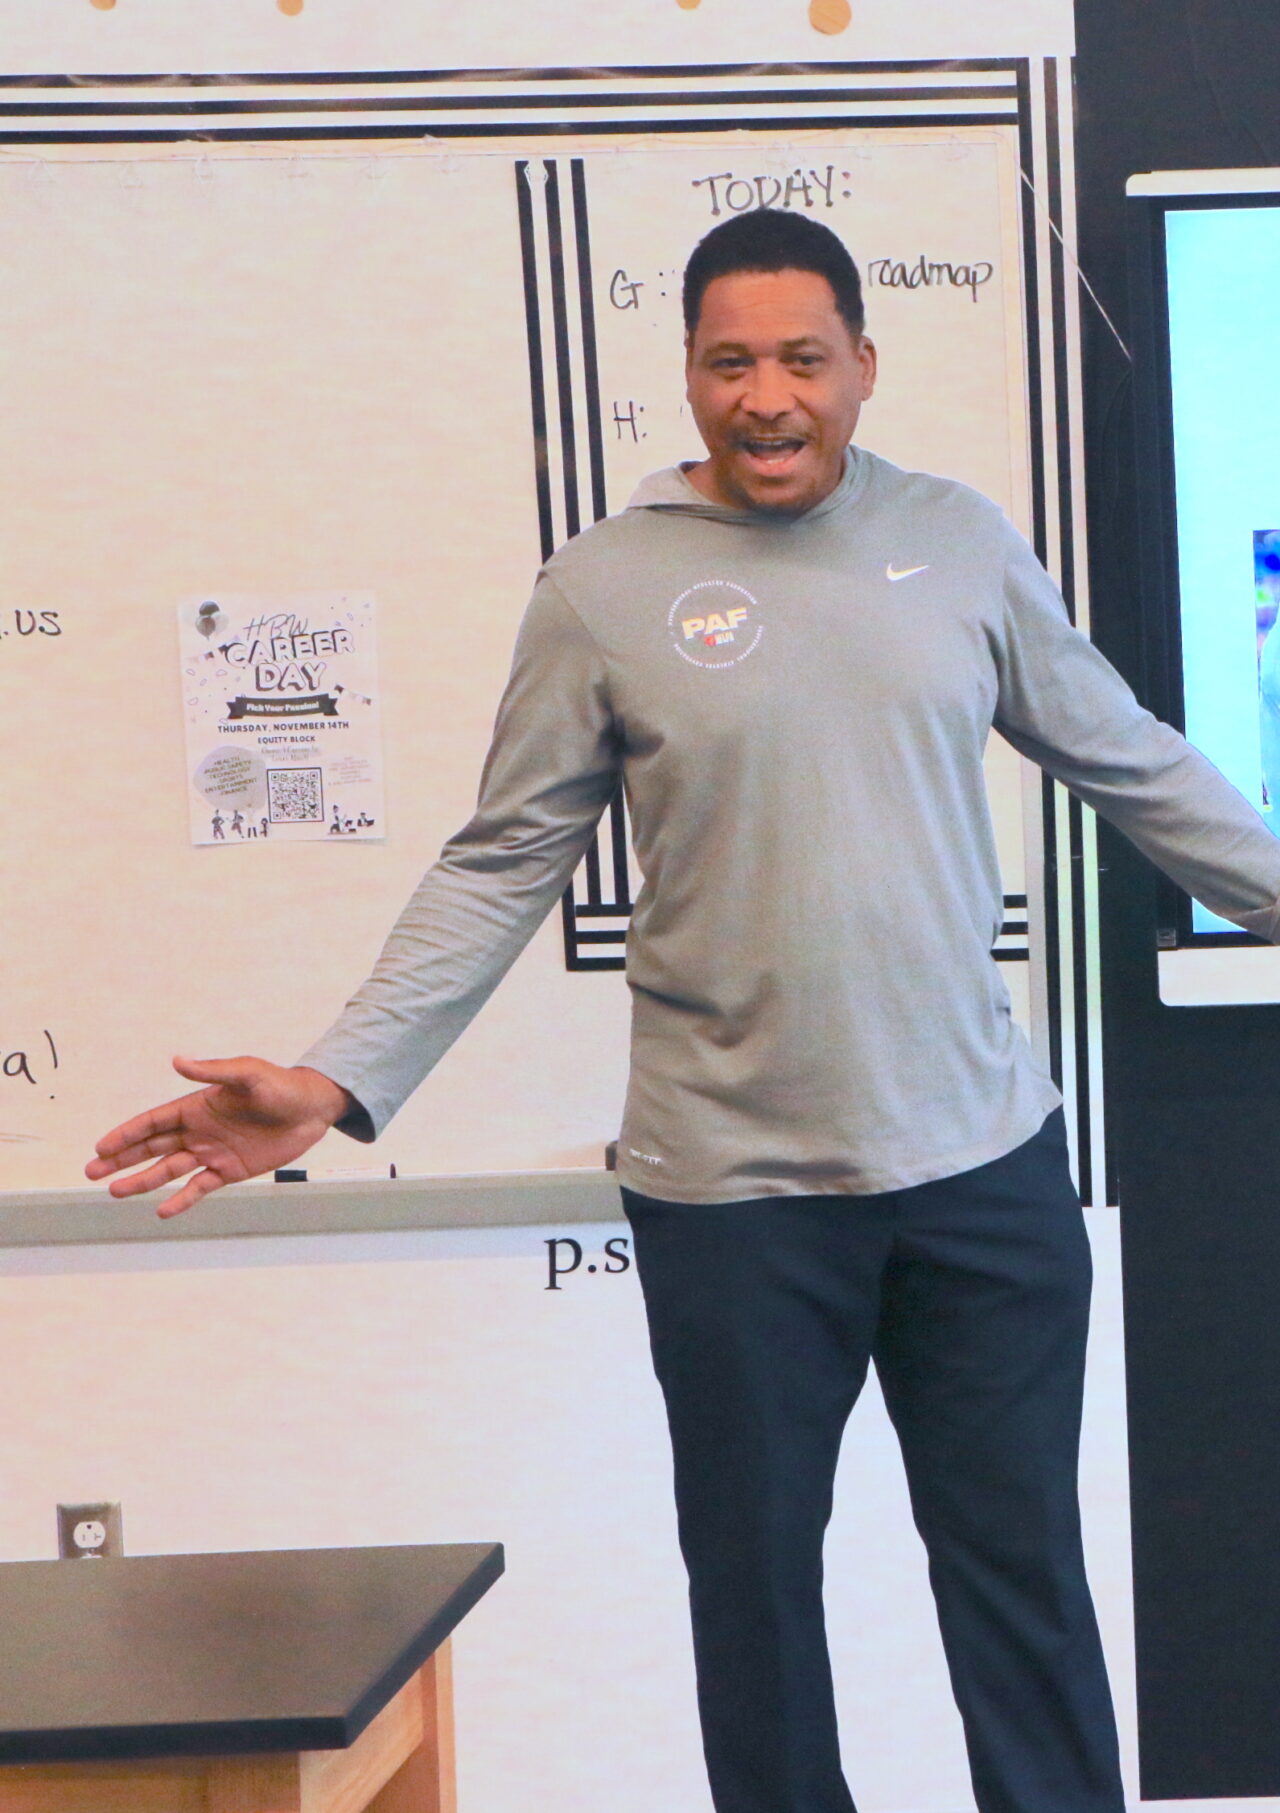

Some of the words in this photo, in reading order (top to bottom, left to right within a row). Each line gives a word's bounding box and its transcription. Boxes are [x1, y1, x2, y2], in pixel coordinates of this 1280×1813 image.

[691, 164, 853, 215] TODAY:
[868, 255, 993, 303] roadmap
[681, 607, 748, 640] PAF
[224, 628, 355, 668] CAREER
[255, 661, 327, 692] DAY
[257, 736, 287, 744] EQUITY
[273, 722, 325, 731] NOVEMBER
[327, 721, 350, 729] 14TH
